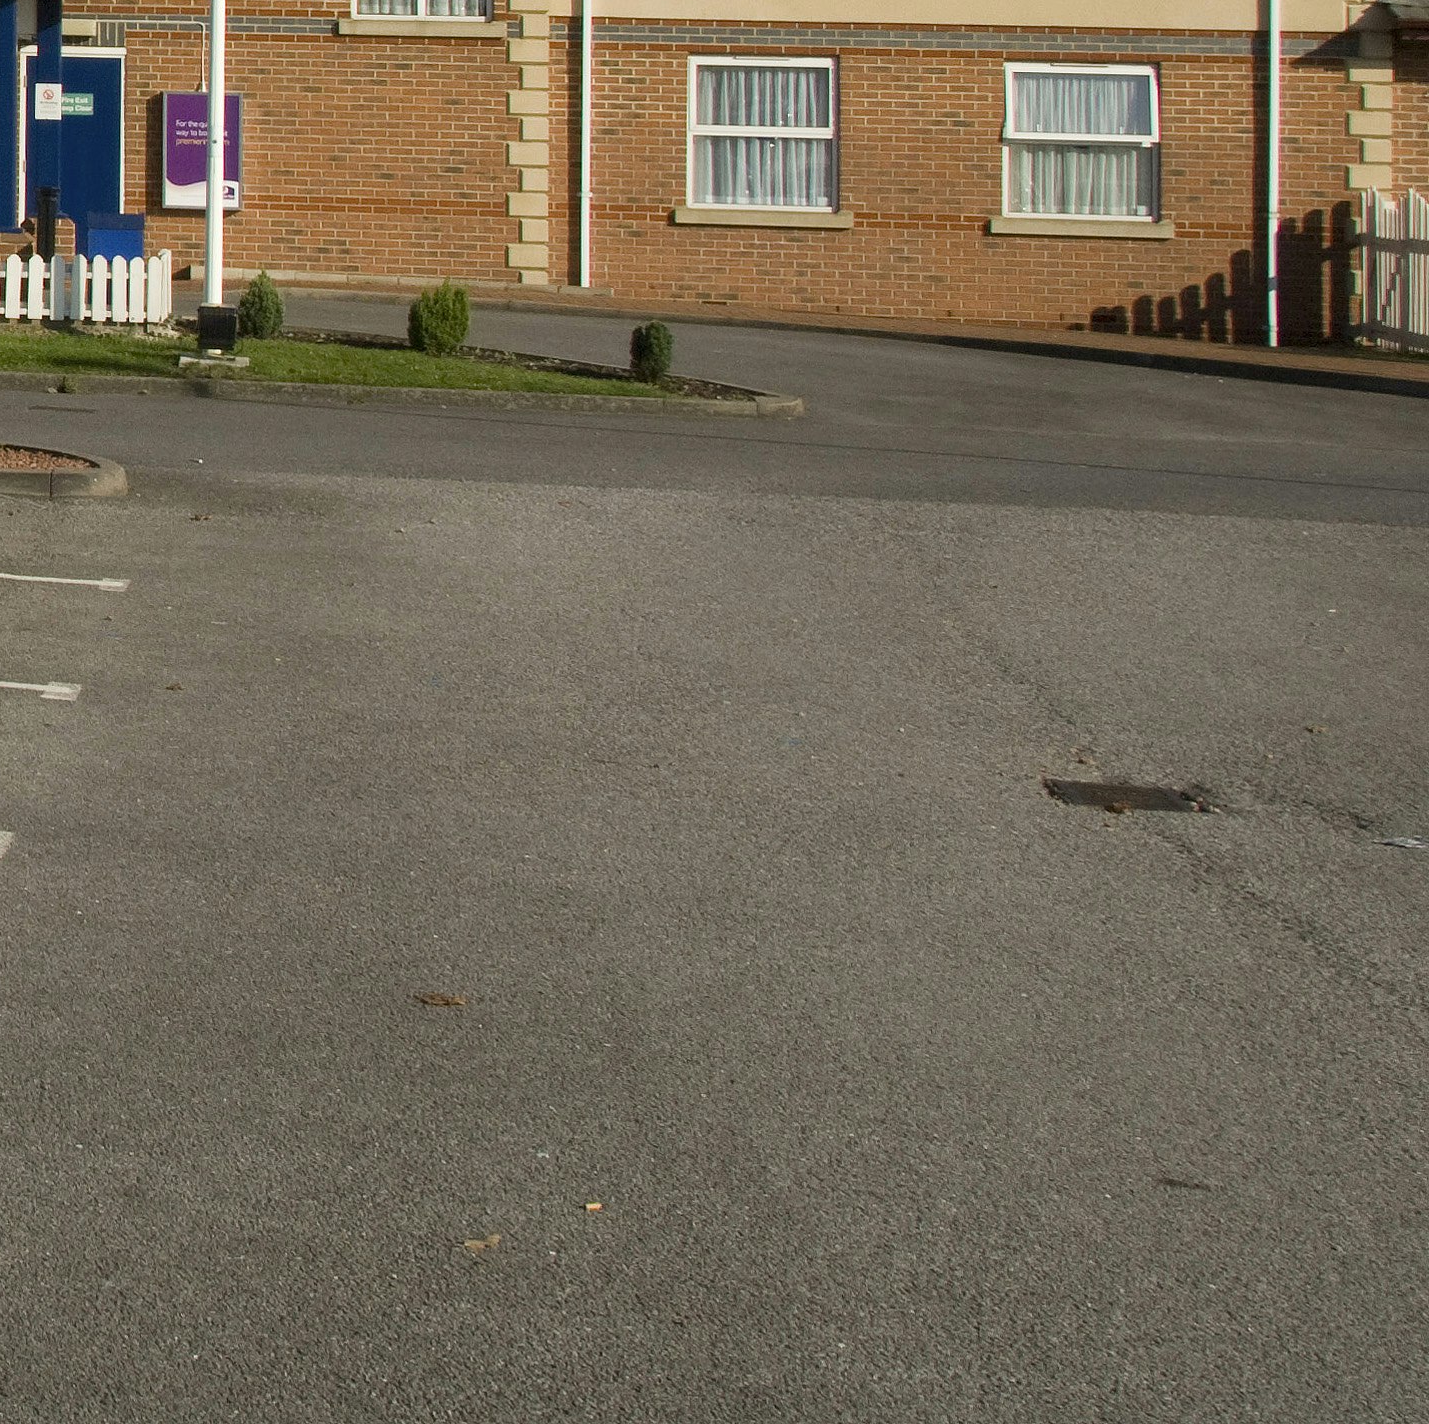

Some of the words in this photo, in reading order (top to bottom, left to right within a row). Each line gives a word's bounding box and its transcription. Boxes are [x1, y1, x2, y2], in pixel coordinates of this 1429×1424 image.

[175, 119, 187, 128] For
[188, 120, 199, 128] the
[190, 129, 198, 137] to
